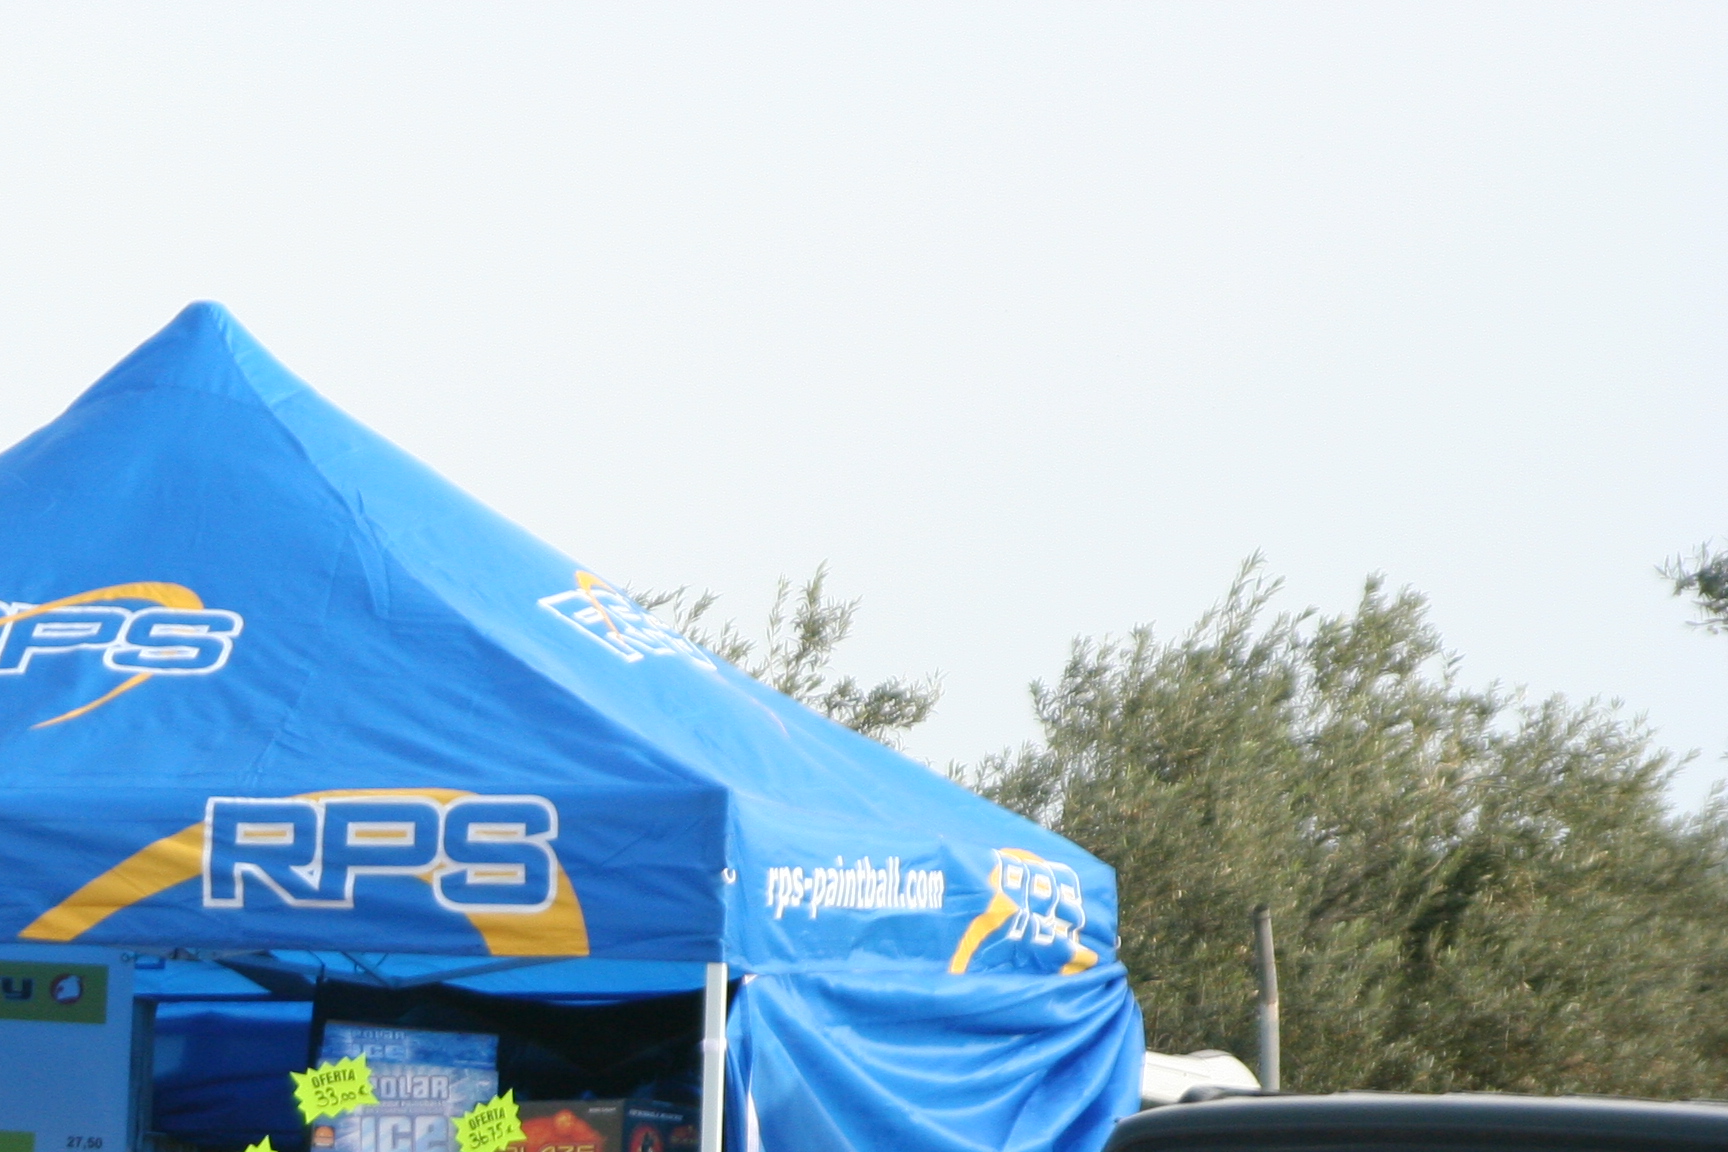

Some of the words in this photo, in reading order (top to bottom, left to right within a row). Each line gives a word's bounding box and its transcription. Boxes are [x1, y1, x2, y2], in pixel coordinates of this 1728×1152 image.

[204, 794, 558, 912] RPS
[767, 856, 945, 919] rps-paintball.com
[311, 1069, 356, 1089] OFERTA
[469, 1107, 506, 1129] OFERTA
[67, 1136, 103, 1150] 27,50
